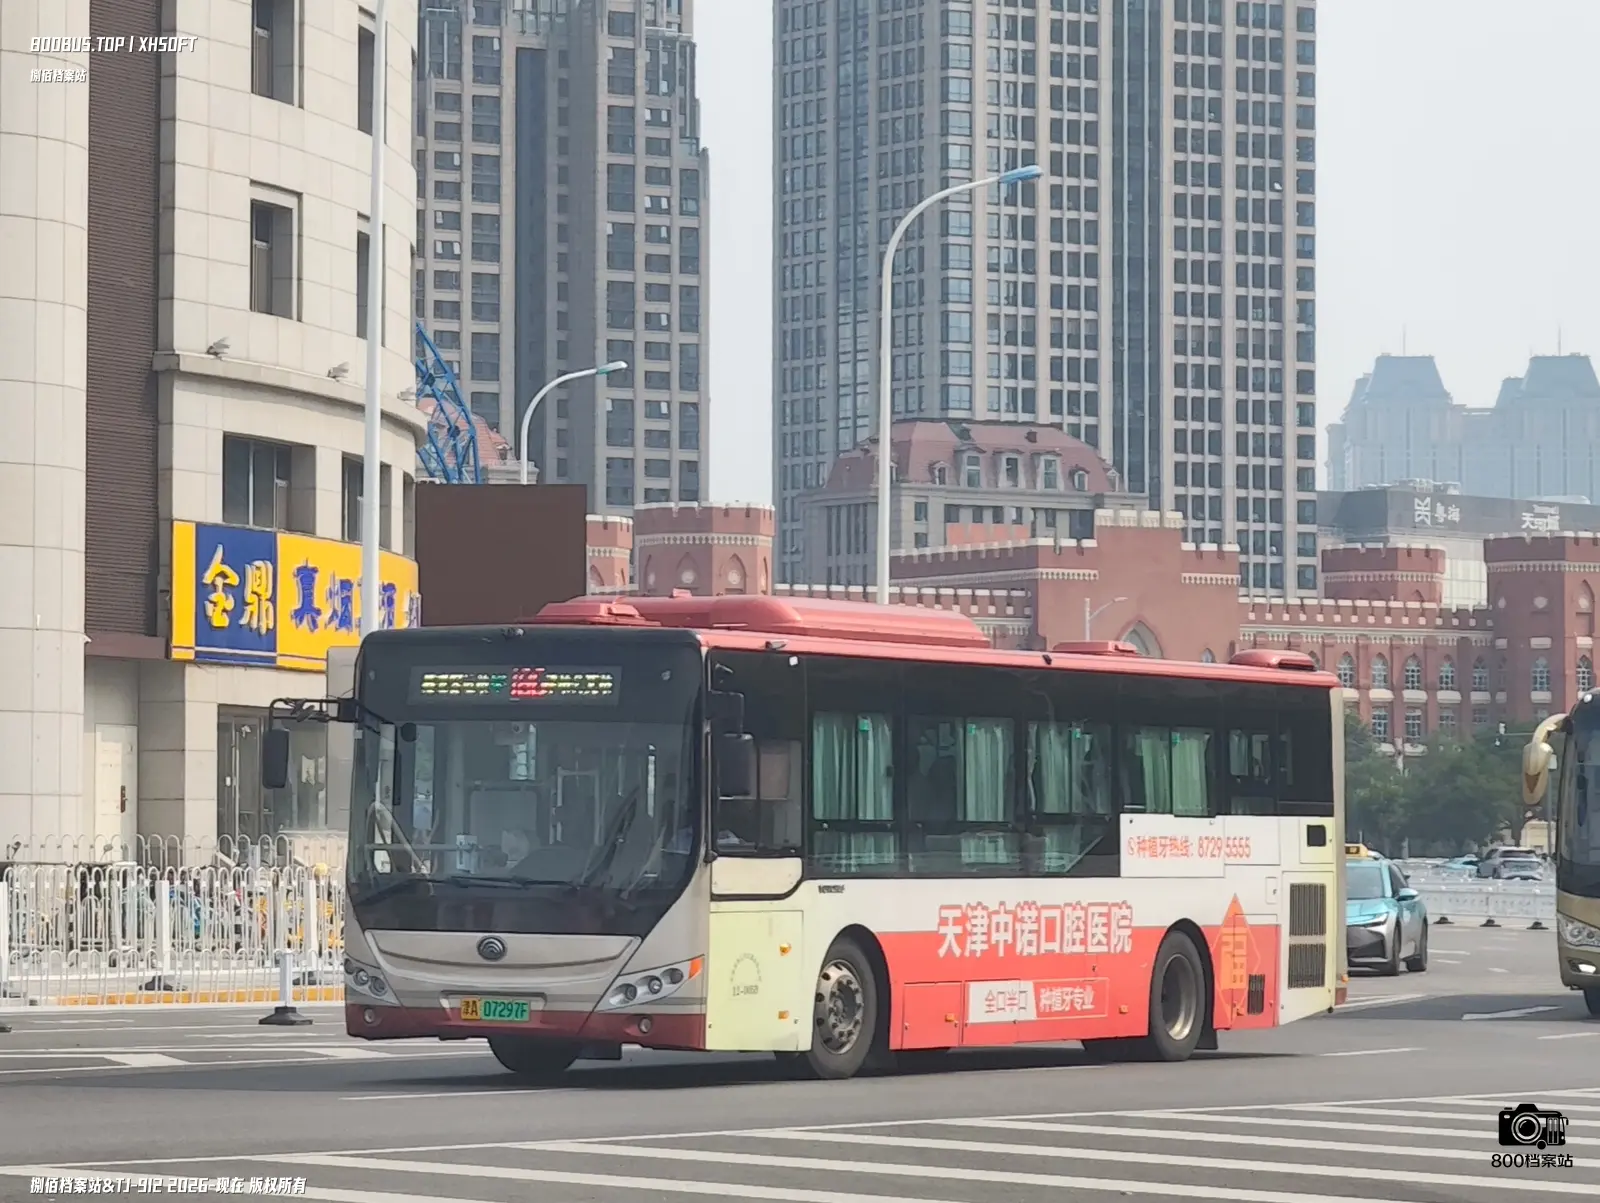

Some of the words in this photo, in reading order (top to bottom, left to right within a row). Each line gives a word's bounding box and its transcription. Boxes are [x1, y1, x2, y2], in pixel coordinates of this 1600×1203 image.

[202, 543, 274, 635] 金鼎
[1198, 835, 1222, 858] 8729
[1225, 835, 1251, 858] 5555
[937, 900, 1133, 958] 天津中诺口腔医院
[483, 1001, 529, 1019] 07297F
